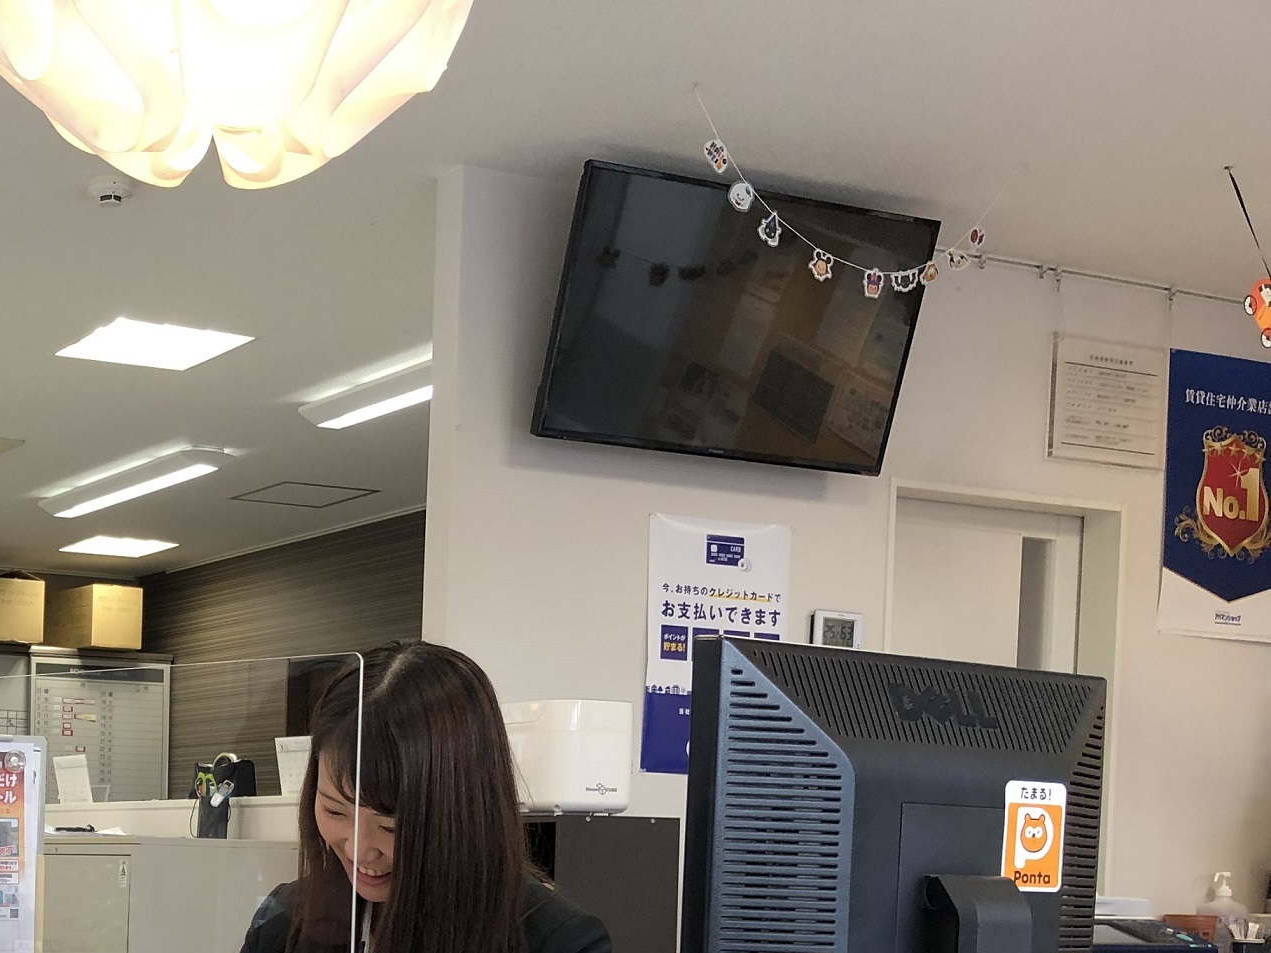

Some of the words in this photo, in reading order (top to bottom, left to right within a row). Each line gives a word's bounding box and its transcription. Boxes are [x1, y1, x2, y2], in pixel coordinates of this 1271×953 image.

[1203, 468, 1260, 522] No.1
[662, 583, 781, 603] 今、お持ちのクレジットカードで
[661, 600, 781, 627] お支払いできます
[1021, 786, 1052, 801] たまる!
[1014, 871, 1051, 885] Ponta
